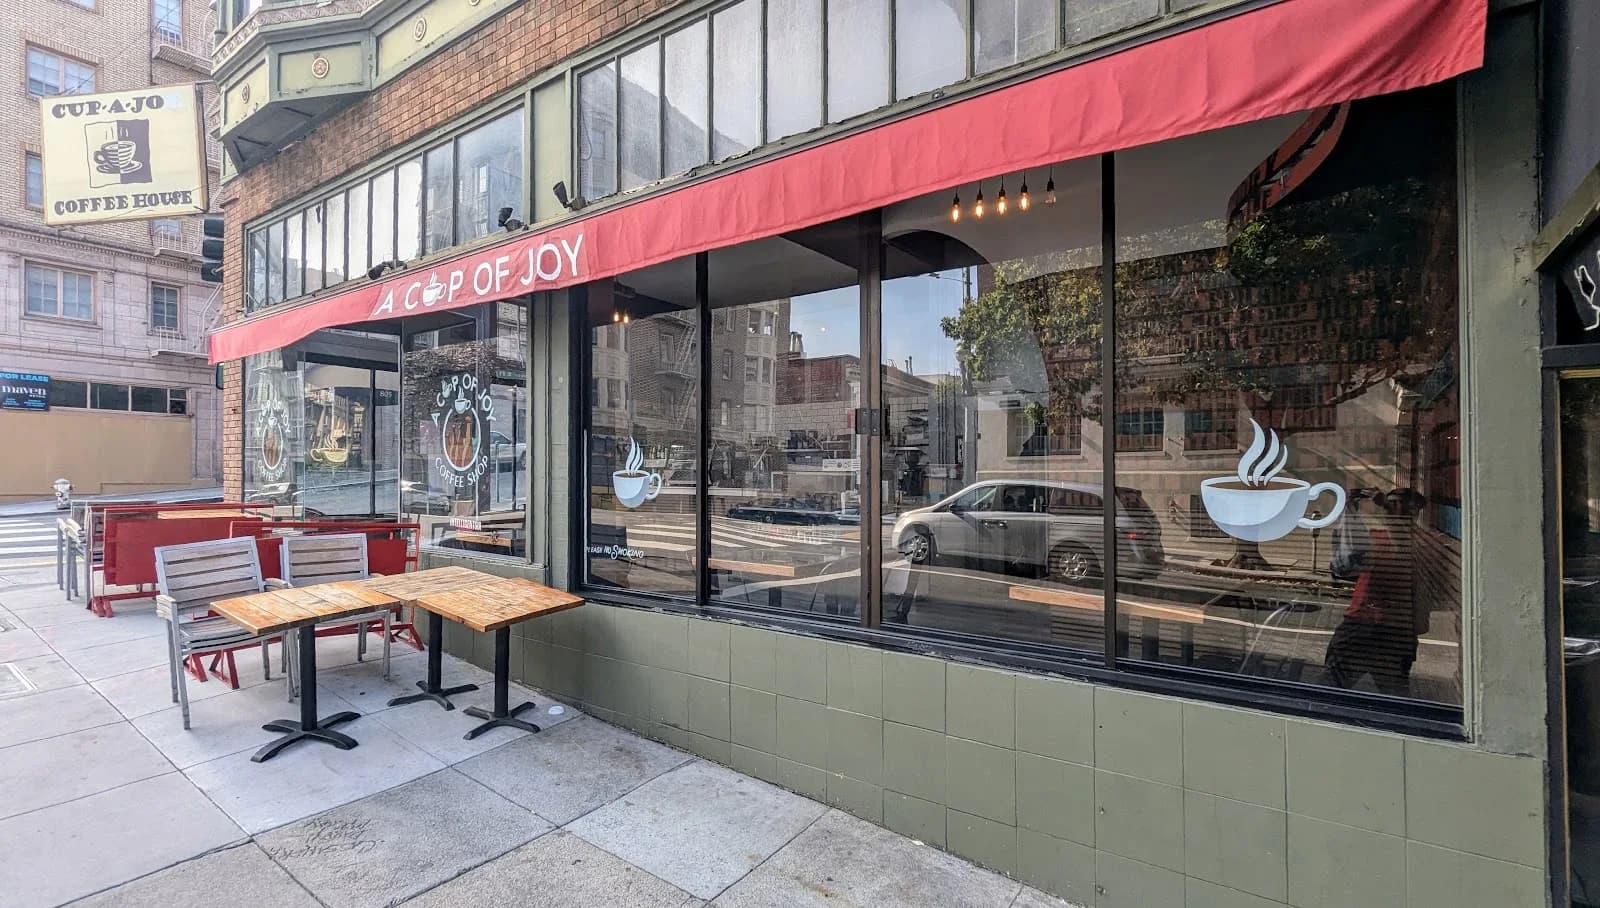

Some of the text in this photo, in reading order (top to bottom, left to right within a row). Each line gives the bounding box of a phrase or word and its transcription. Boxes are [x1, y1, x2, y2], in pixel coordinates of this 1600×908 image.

[54, 190, 193, 216] COFFEE HOUSE
[374, 288, 394, 315] A
[473, 255, 511, 296] OF
[520, 234, 584, 286] JOY
[2, 385, 47, 396] maven
[20, 374, 49, 382] LEASE
[431, 412, 440, 428] A
[463, 373, 478, 391] OF
[478, 388, 497, 421] JOY
[435, 455, 488, 488] COFFEE SHOP
[604, 545, 612, 554] NO
[610, 545, 644, 560] SMOKING
